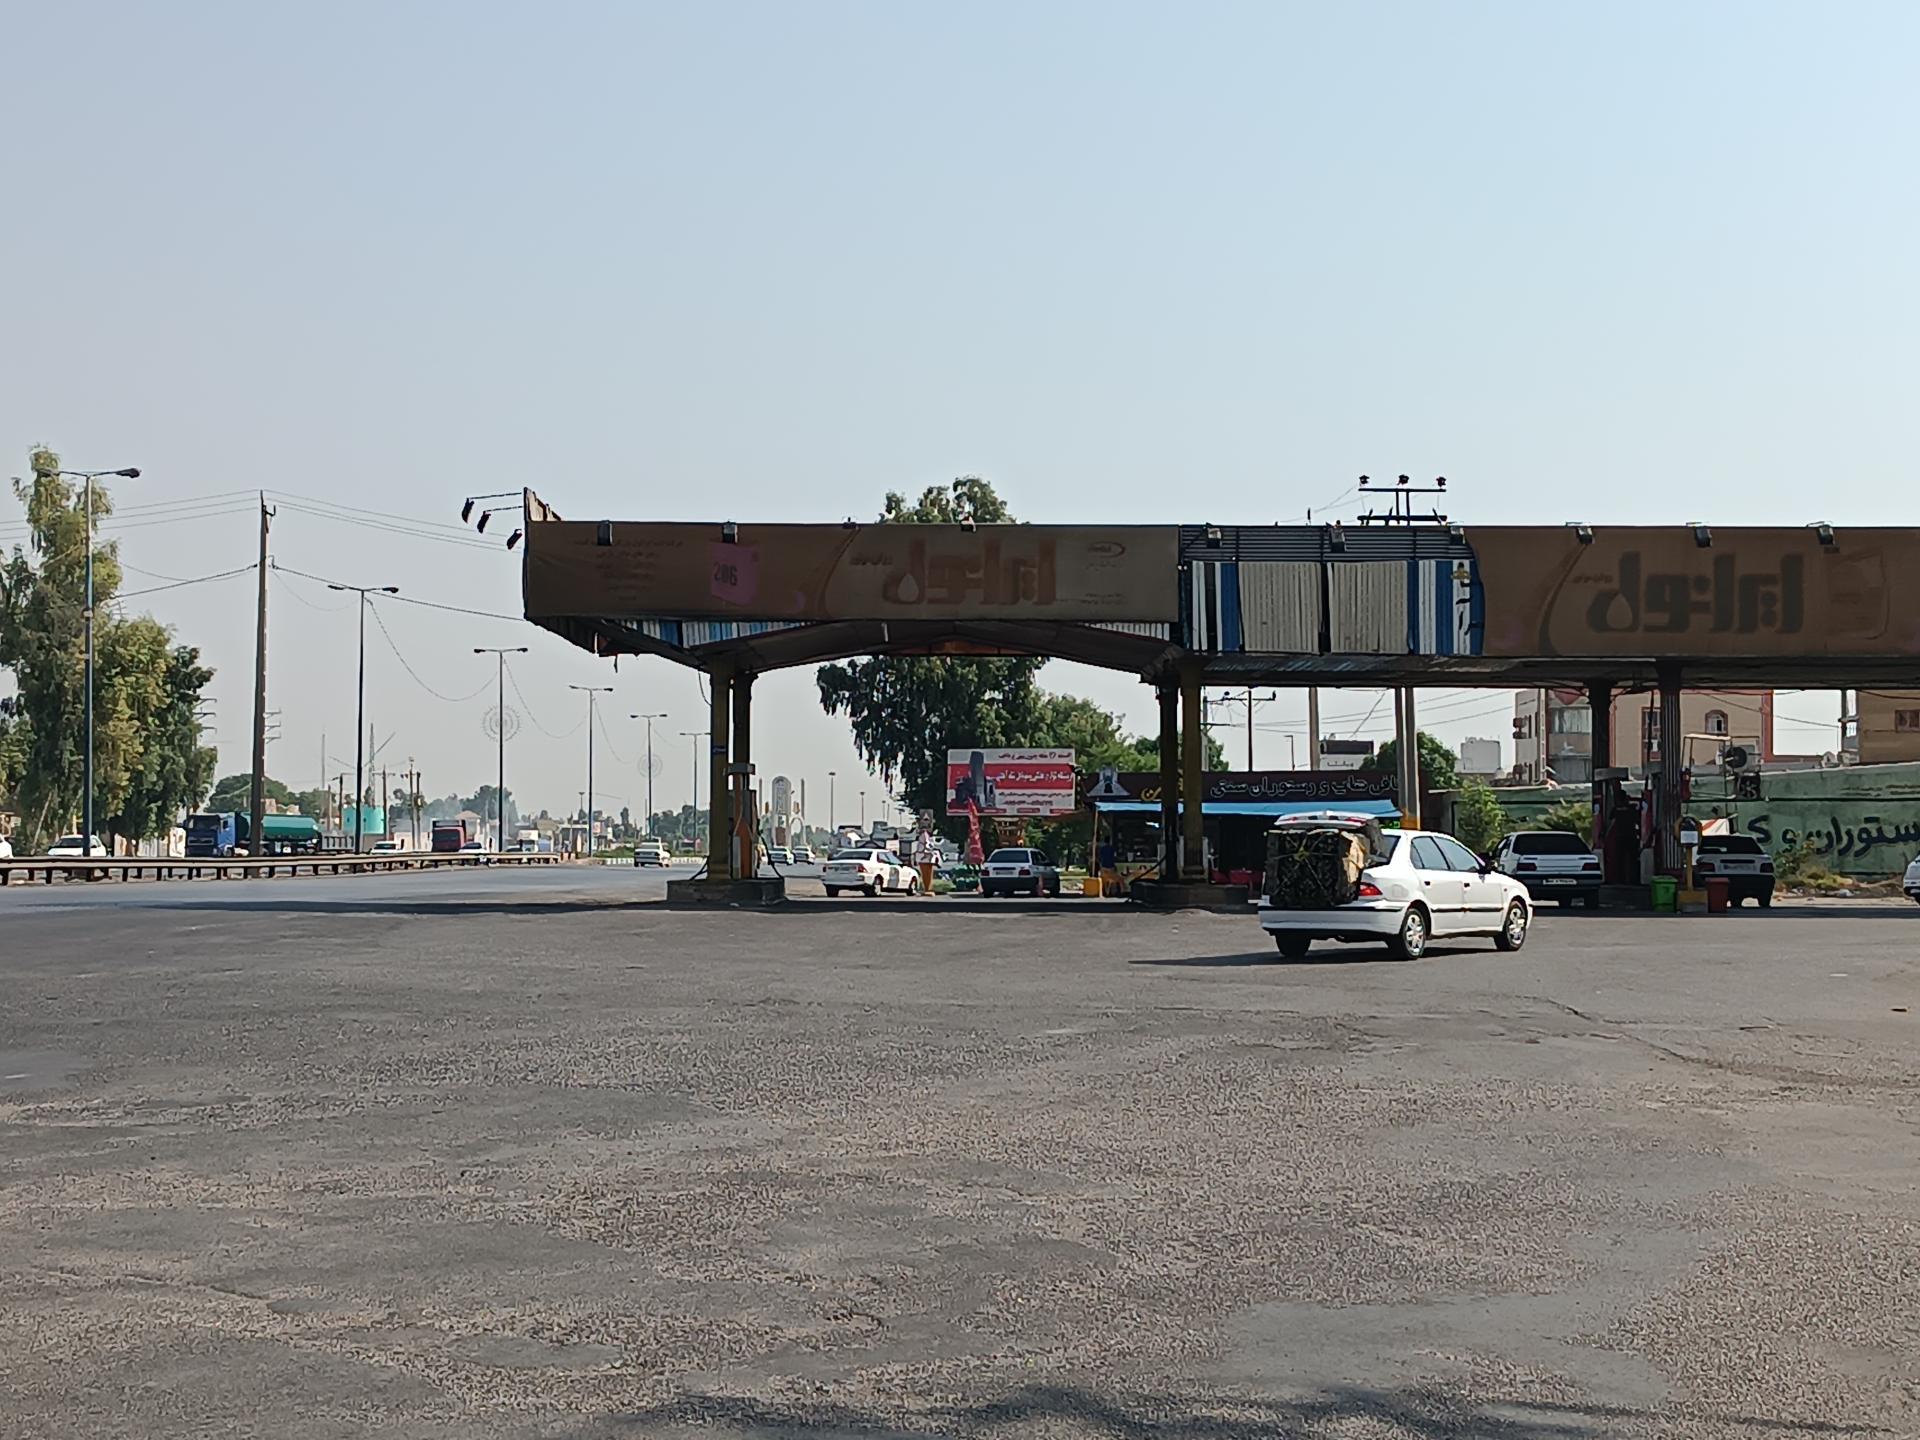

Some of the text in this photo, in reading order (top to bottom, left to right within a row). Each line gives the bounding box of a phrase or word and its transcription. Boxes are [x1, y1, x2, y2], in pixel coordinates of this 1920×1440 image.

[881, 538, 1057, 605] ایرانول
[1586, 551, 1804, 634] ایرانول
[1210, 779, 1249, 798] سنتی
[1249, 776, 1317, 797] رستوران
[1318, 780, 1330, 796] و
